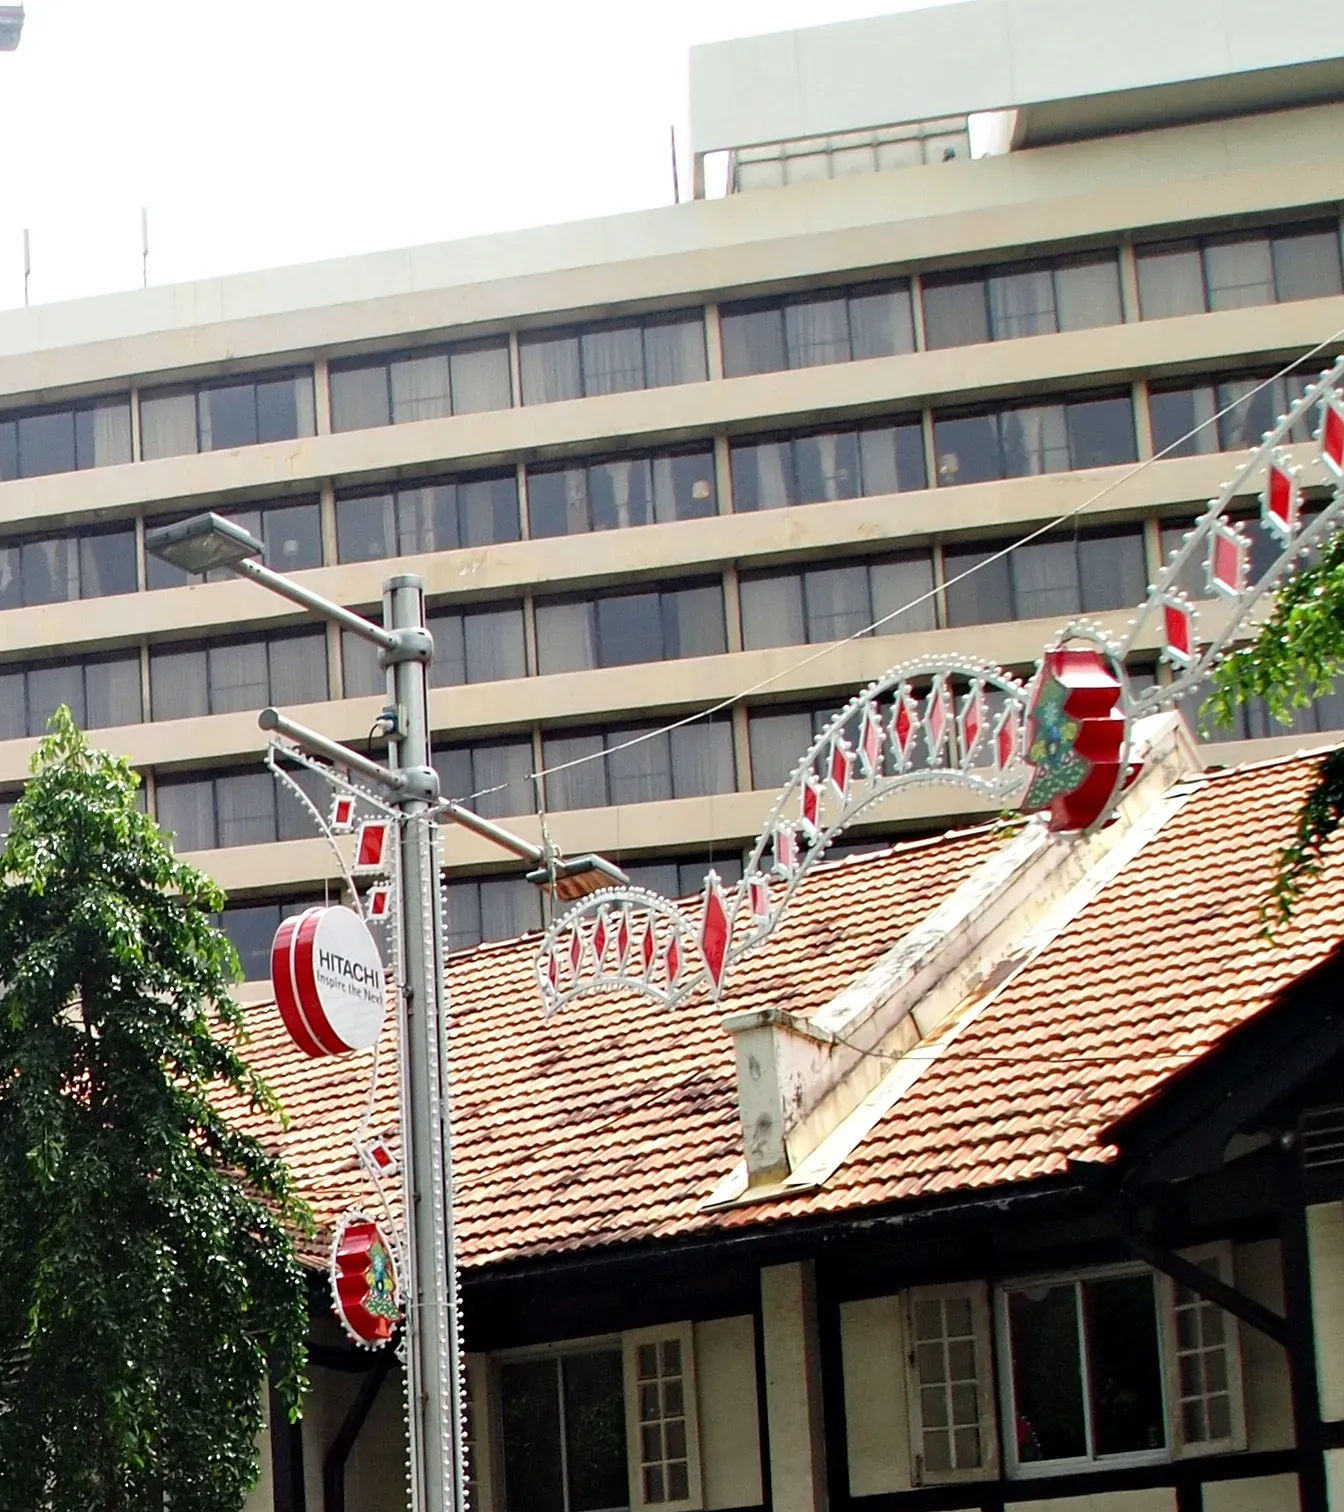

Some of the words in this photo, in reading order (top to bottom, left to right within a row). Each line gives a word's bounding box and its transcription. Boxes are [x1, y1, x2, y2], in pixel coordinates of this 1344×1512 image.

[316, 969, 346, 993] Inspire
[347, 982, 362, 998] the
[319, 948, 379, 989] HITACHI
